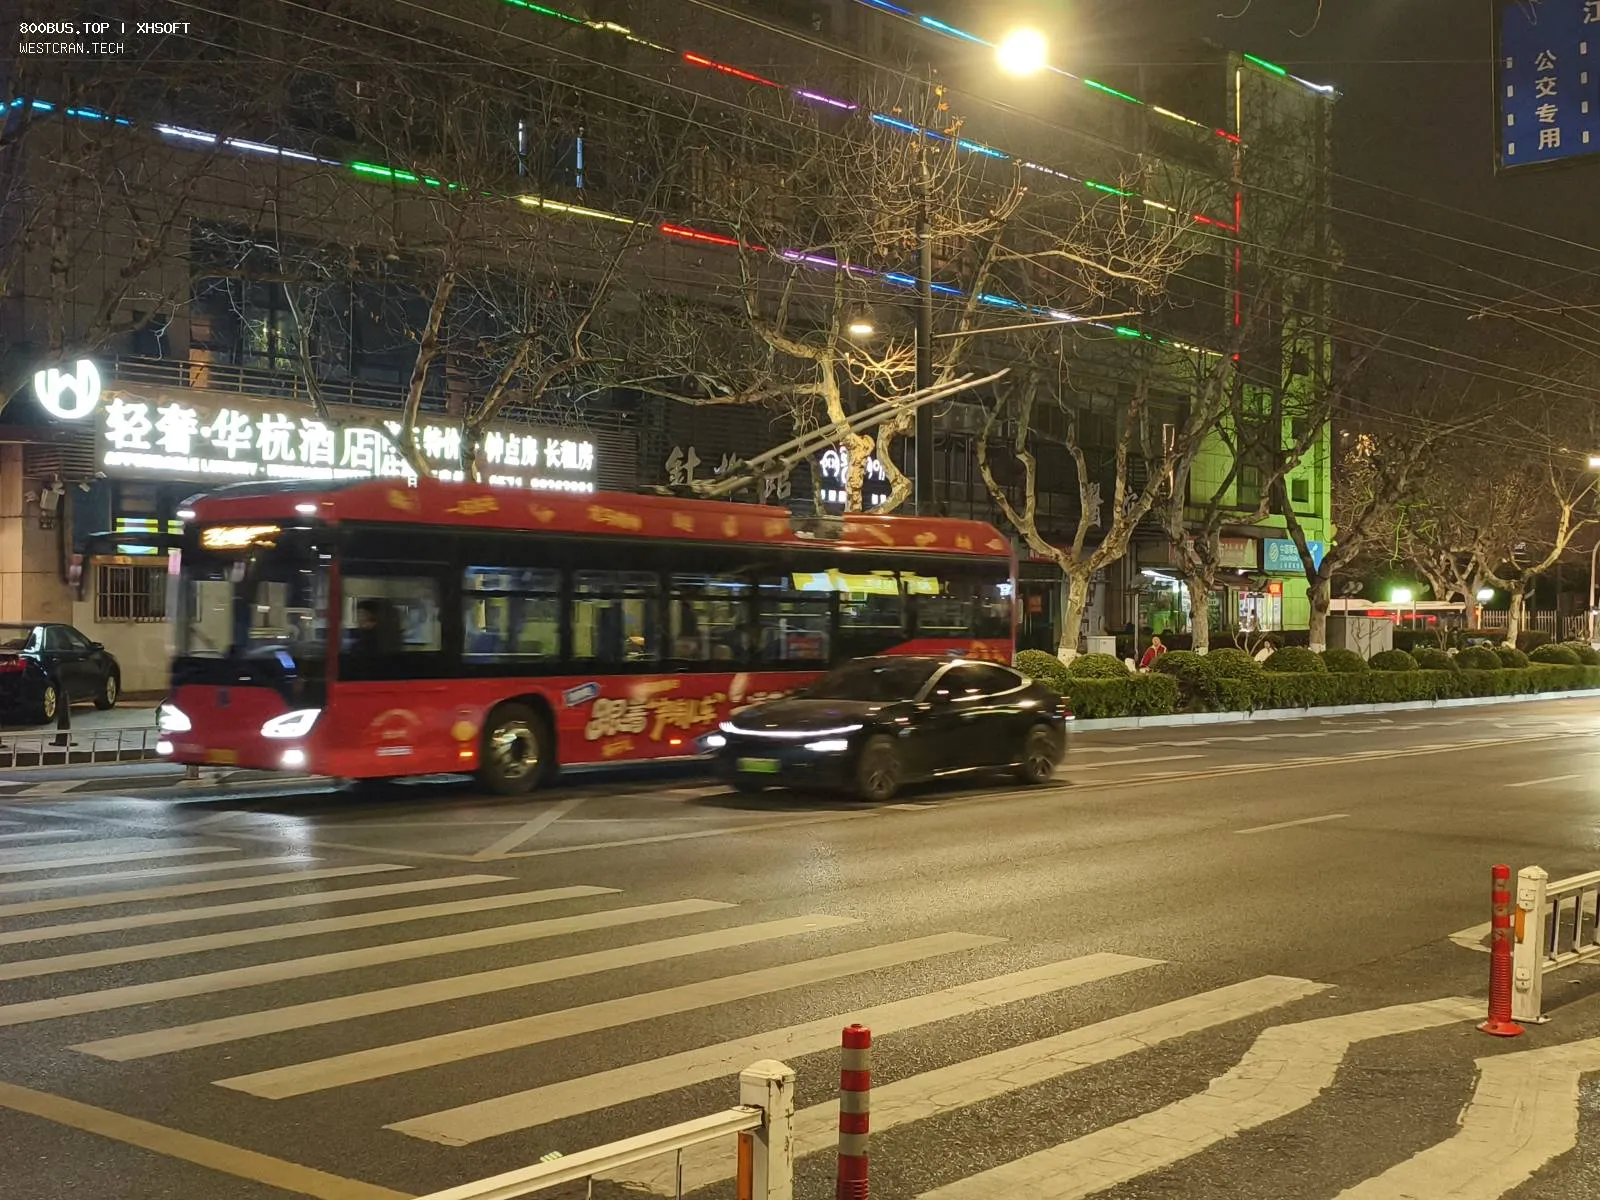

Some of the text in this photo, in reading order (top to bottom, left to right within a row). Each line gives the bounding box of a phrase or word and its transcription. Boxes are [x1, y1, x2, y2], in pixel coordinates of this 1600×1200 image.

[1534, 49, 1561, 150] 公交专用
[484, 431, 538, 466] 钟点房
